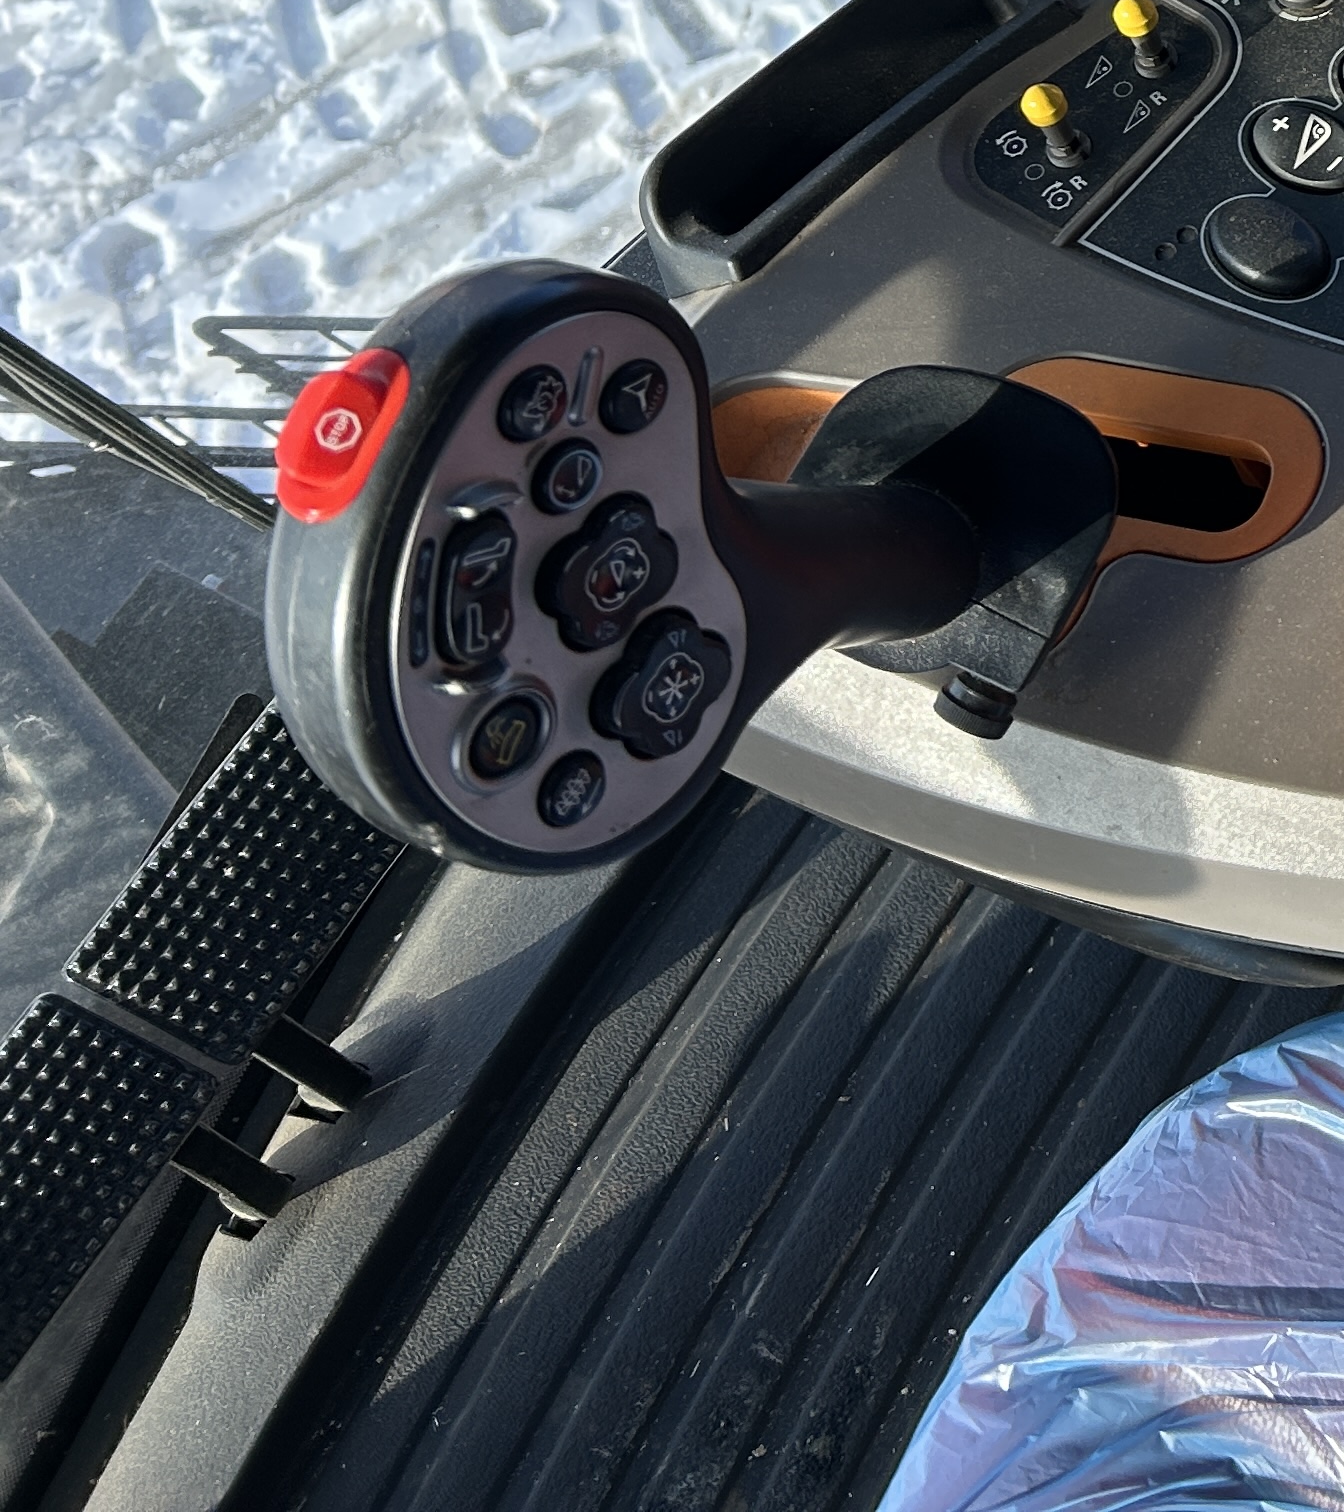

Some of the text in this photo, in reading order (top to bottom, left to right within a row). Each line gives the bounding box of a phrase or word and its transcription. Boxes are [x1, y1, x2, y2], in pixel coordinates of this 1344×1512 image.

[1149, 91, 1168, 106] R
[1069, 175, 1088, 190] R
[325, 415, 349, 446] STOP
